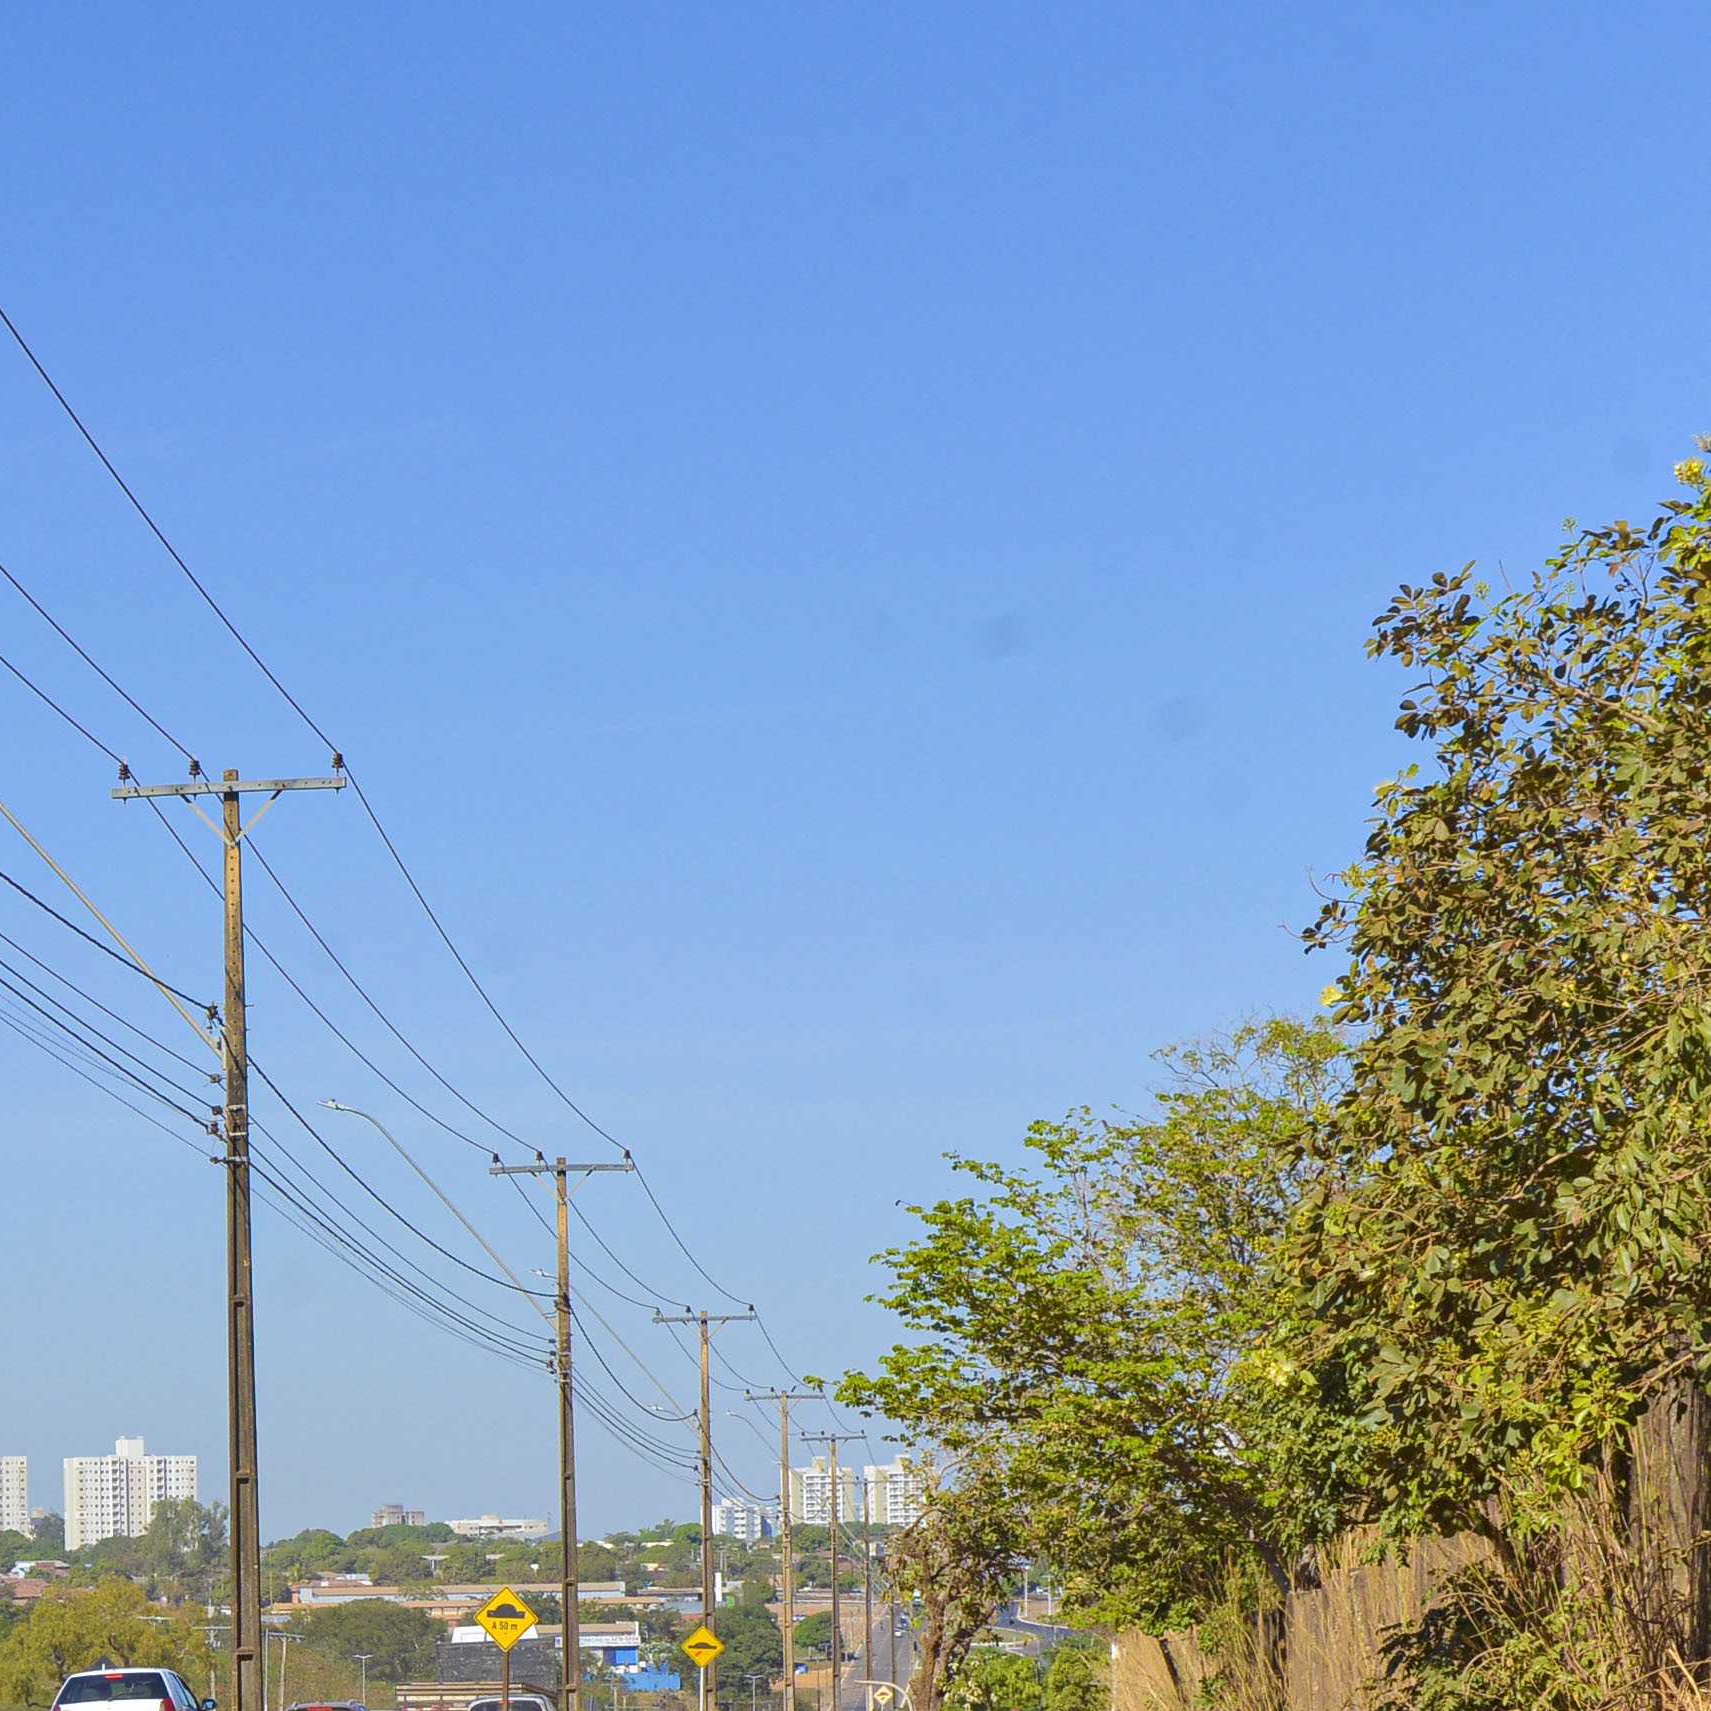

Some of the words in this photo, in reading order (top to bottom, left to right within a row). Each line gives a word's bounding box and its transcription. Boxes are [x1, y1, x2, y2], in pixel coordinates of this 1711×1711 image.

[491, 1621, 498, 1630] A
[499, 1621, 509, 1631] 50
[510, 1623, 518, 1631] m
